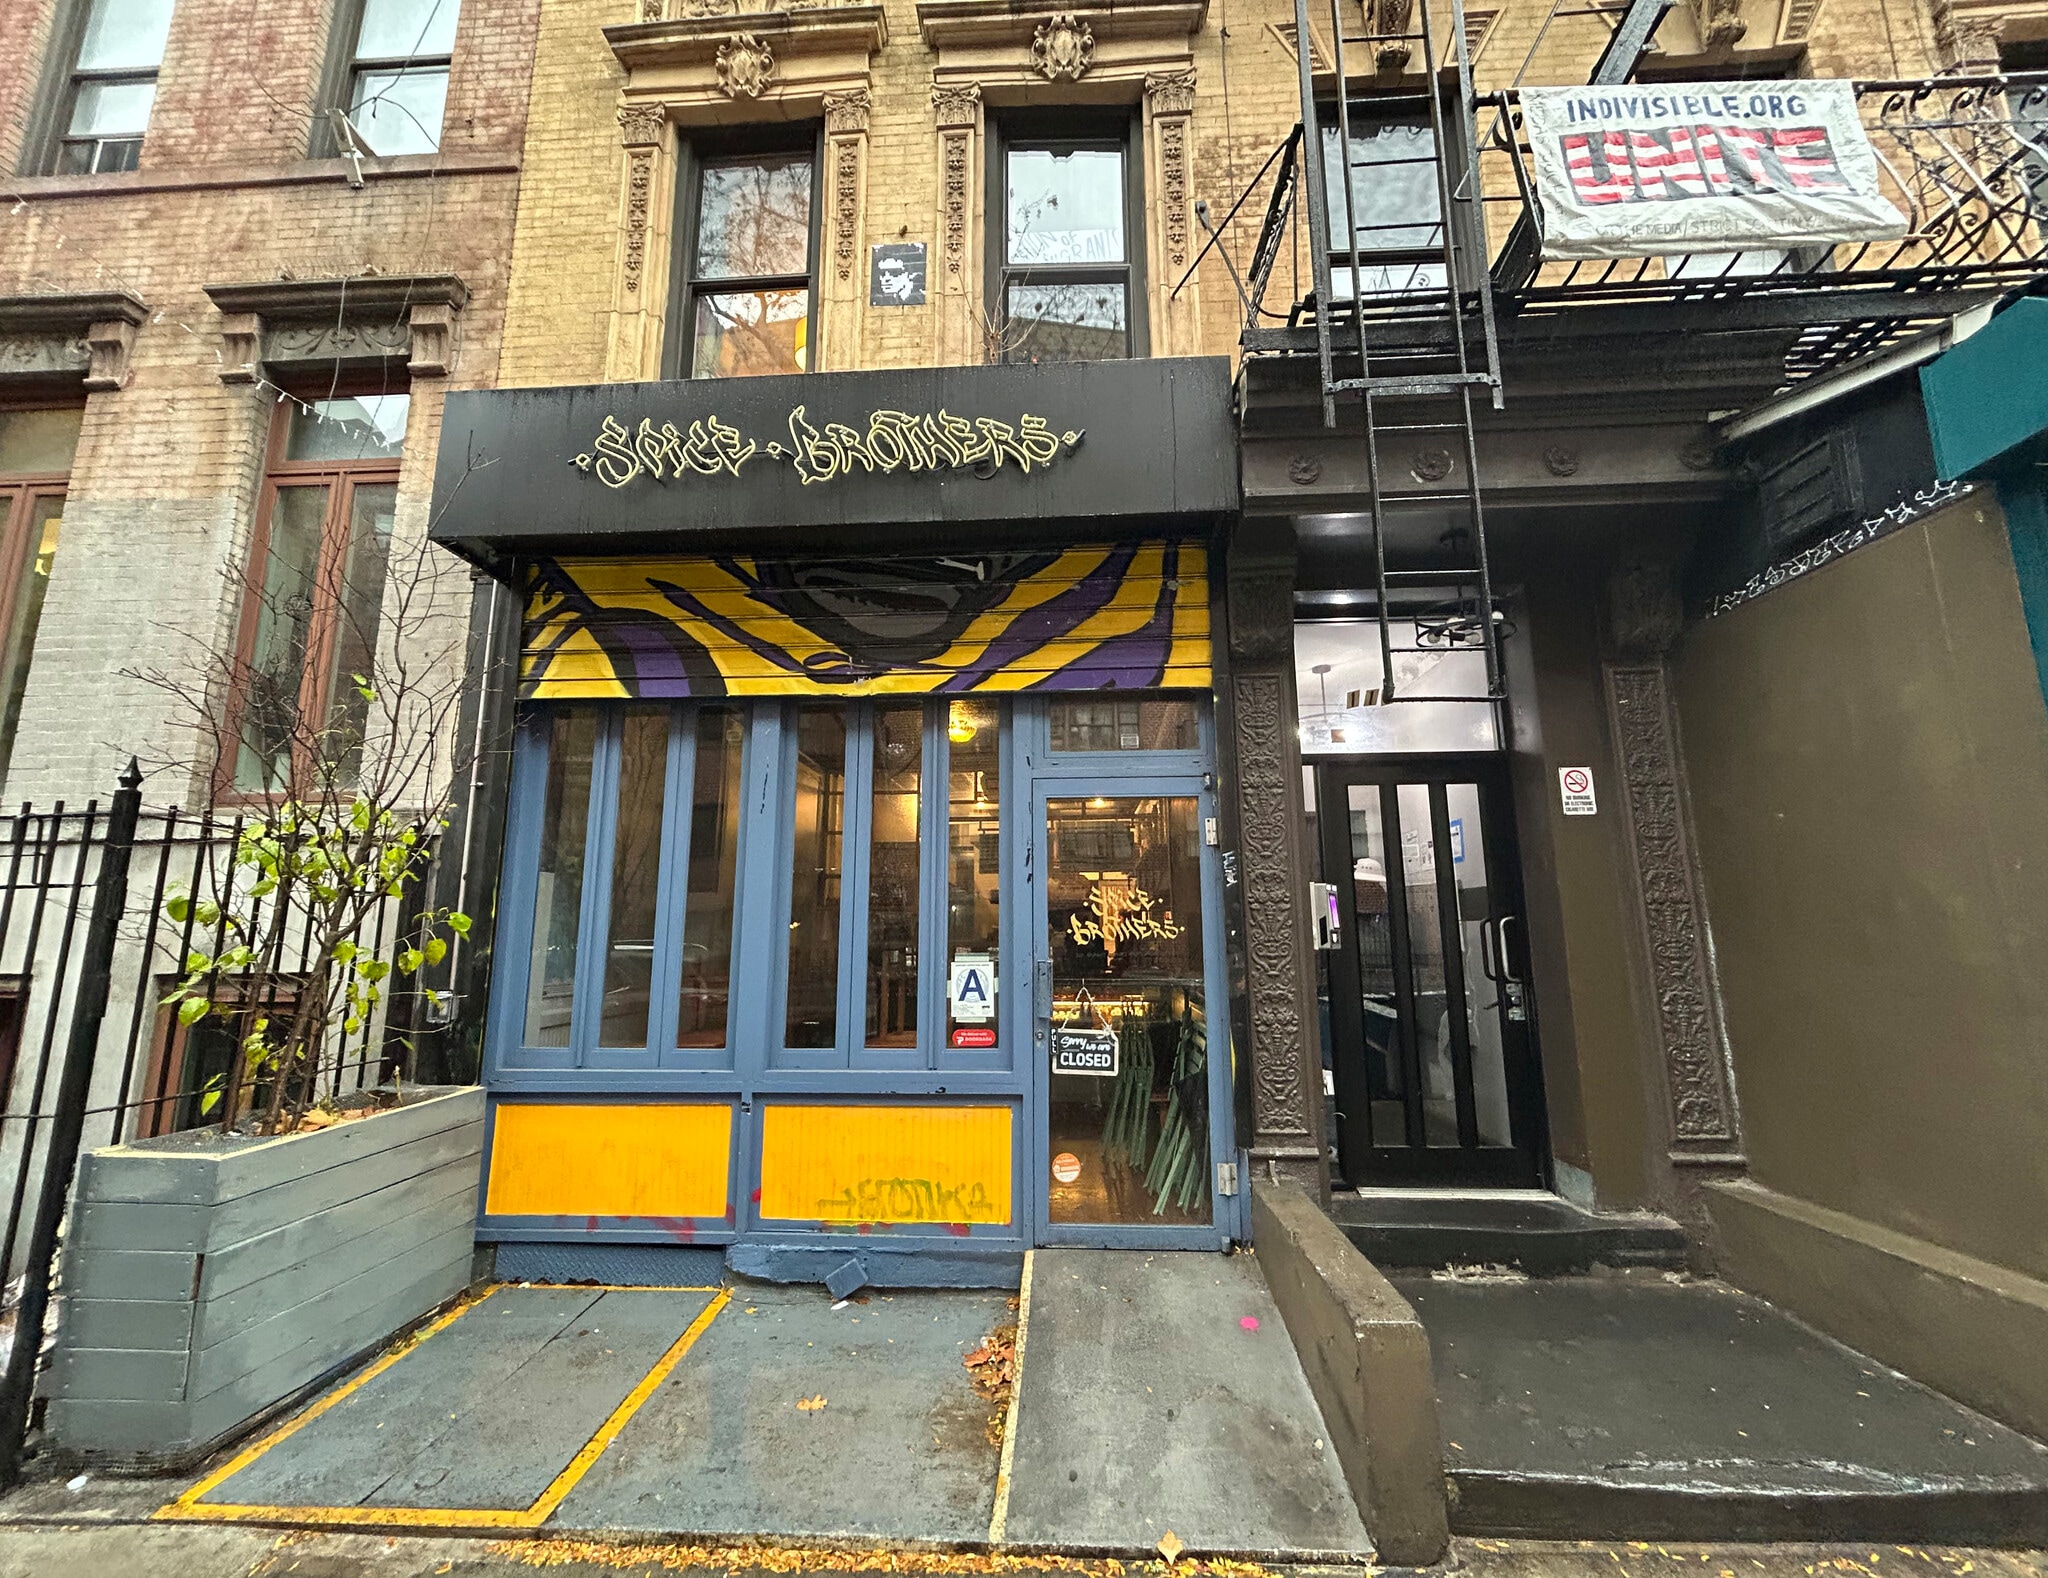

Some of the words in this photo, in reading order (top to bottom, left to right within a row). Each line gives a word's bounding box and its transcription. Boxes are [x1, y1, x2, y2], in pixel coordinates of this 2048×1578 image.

[1567, 94, 1807, 123] INDIVISIBLE.ORG
[789, 405, 1059, 485] BROTHERS
[1070, 912, 1179, 946] BROTHERS
[958, 968, 987, 1002] A
[1060, 1035, 1087, 1050] Sorry
[1085, 1043, 1097, 1051] we
[1097, 1043, 1111, 1051] are
[1060, 1052, 1111, 1067] CLOSED
